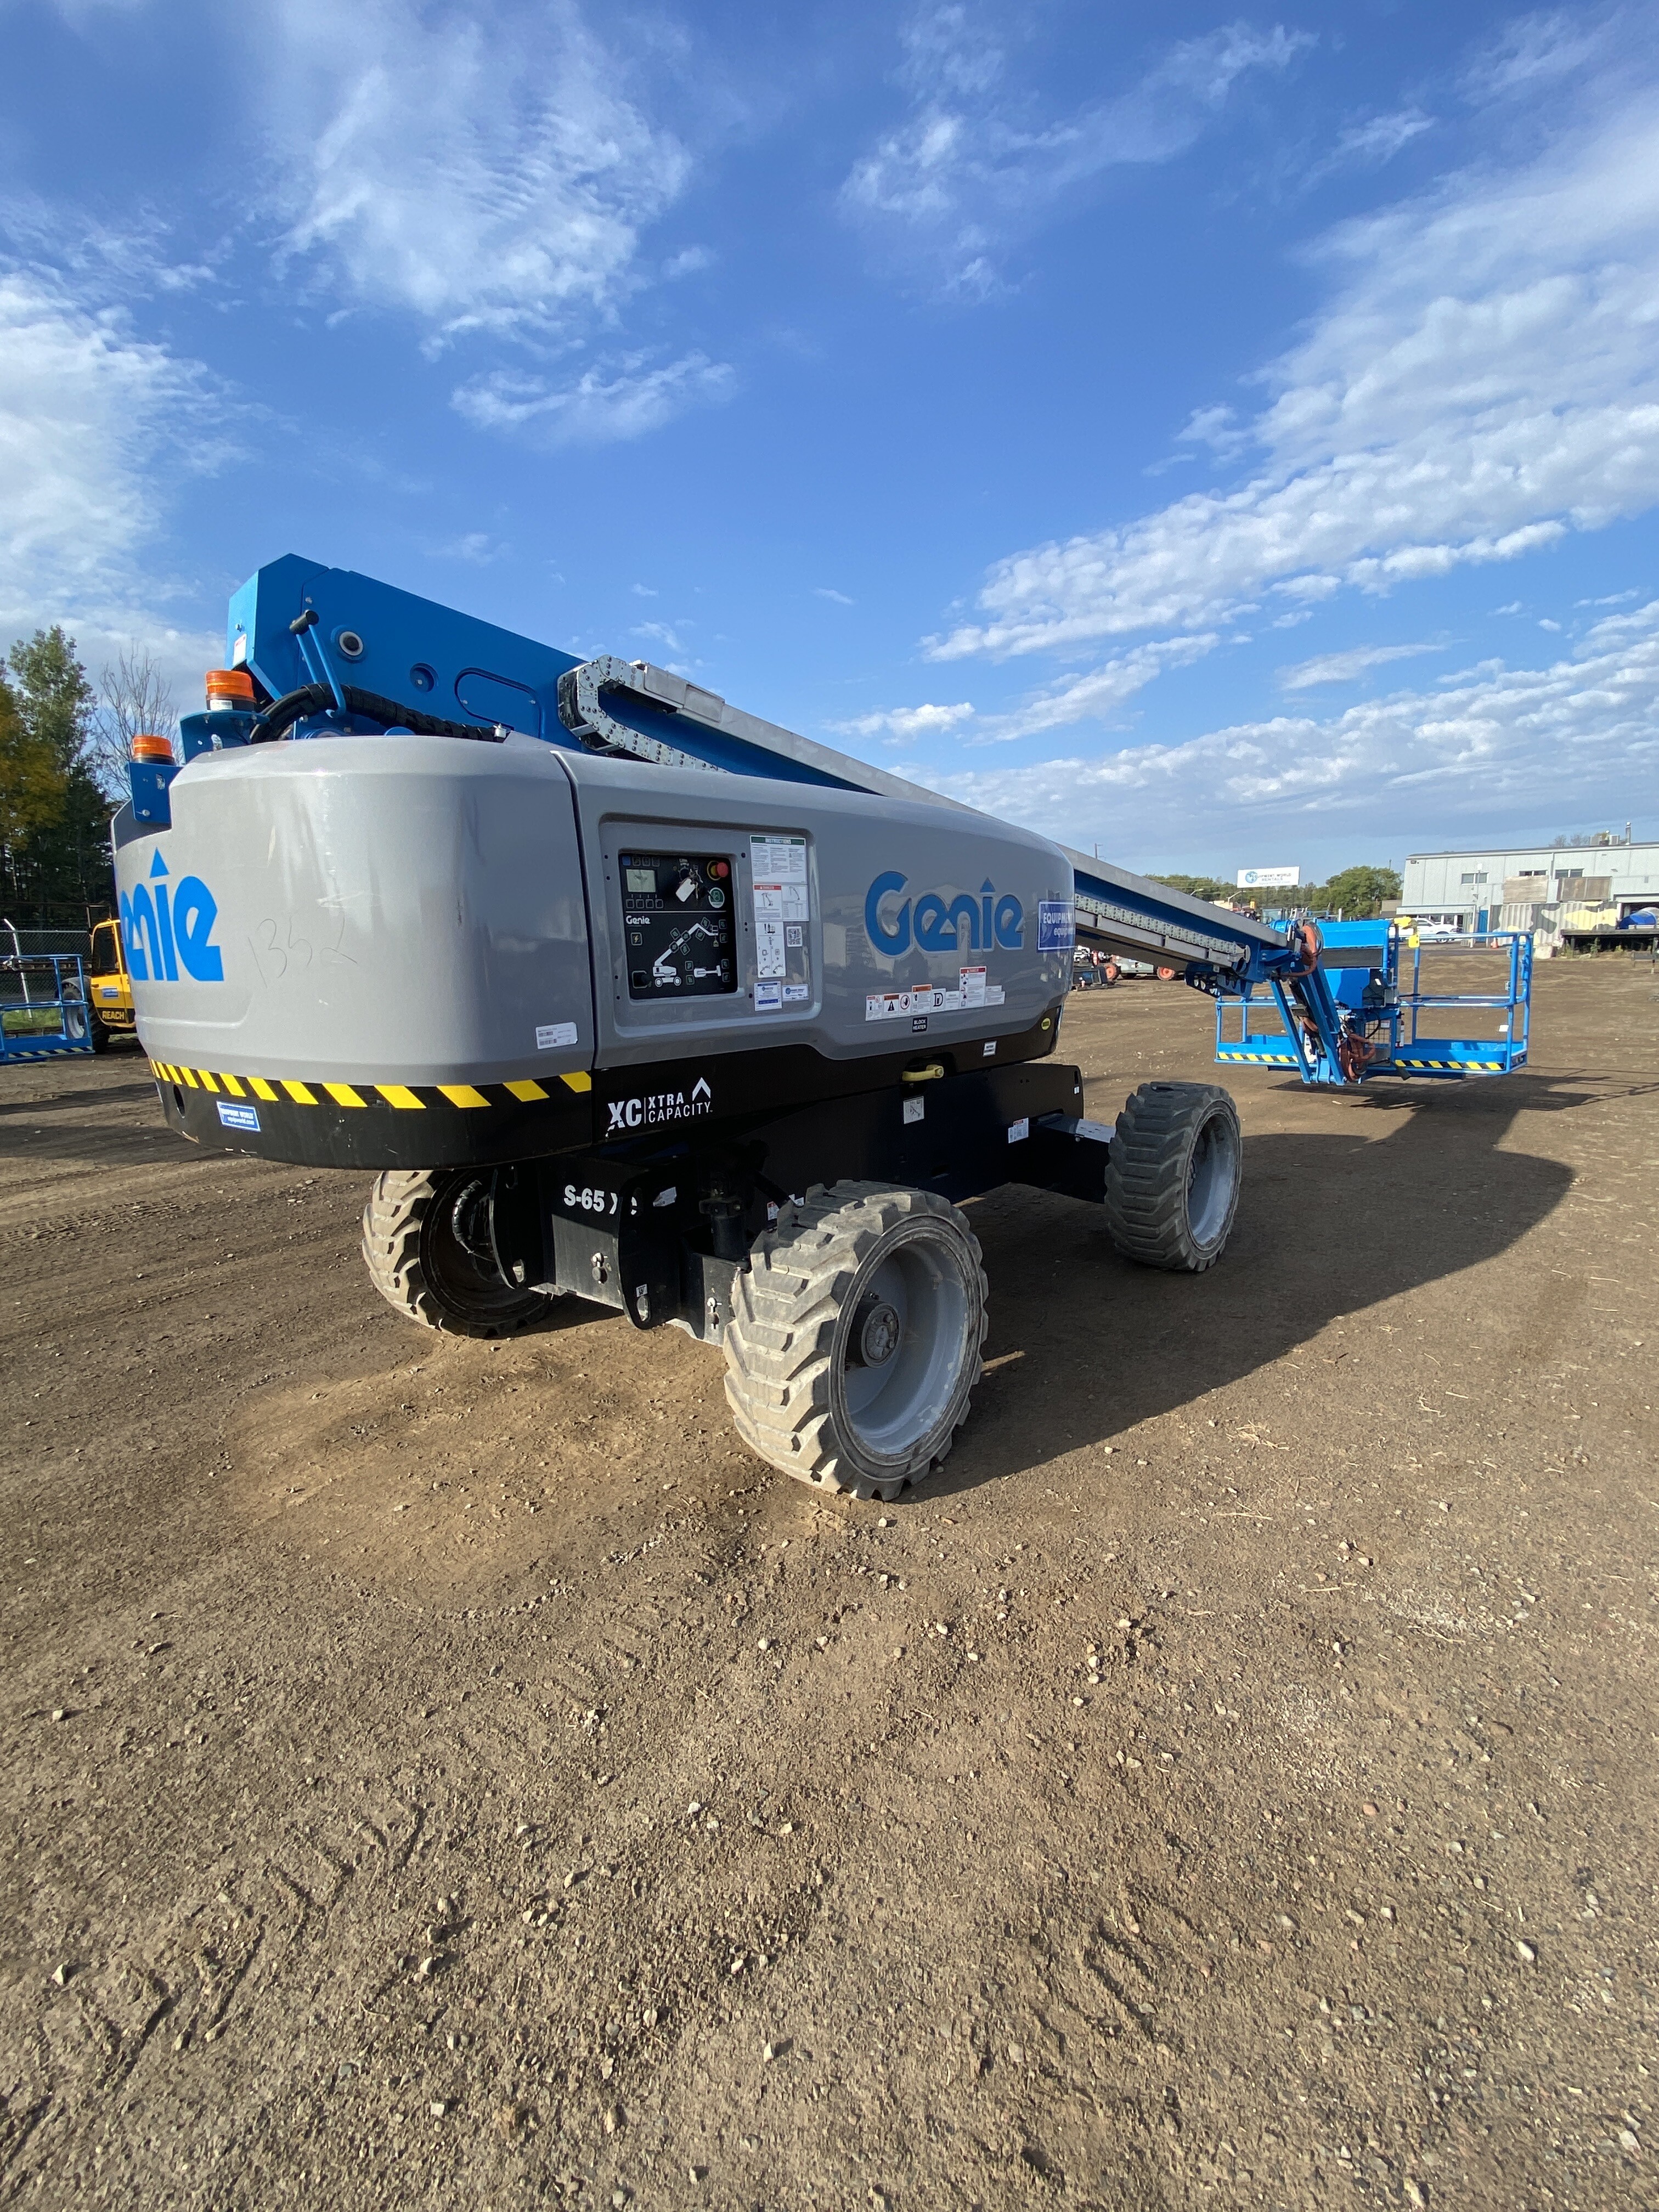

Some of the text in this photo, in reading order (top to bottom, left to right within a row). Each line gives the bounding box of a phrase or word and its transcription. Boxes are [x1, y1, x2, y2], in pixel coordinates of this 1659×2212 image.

[120, 847, 224, 981] enie
[626, 915, 651, 924] Genie
[865, 871, 1024, 957] Genie
[102, 1011, 125, 1020] REACH
[648, 1092, 684, 1109] XTRA
[648, 1101, 712, 1123] CAPACITY
[607, 1098, 642, 1129] XC
[563, 1184, 605, 1212] S-65
